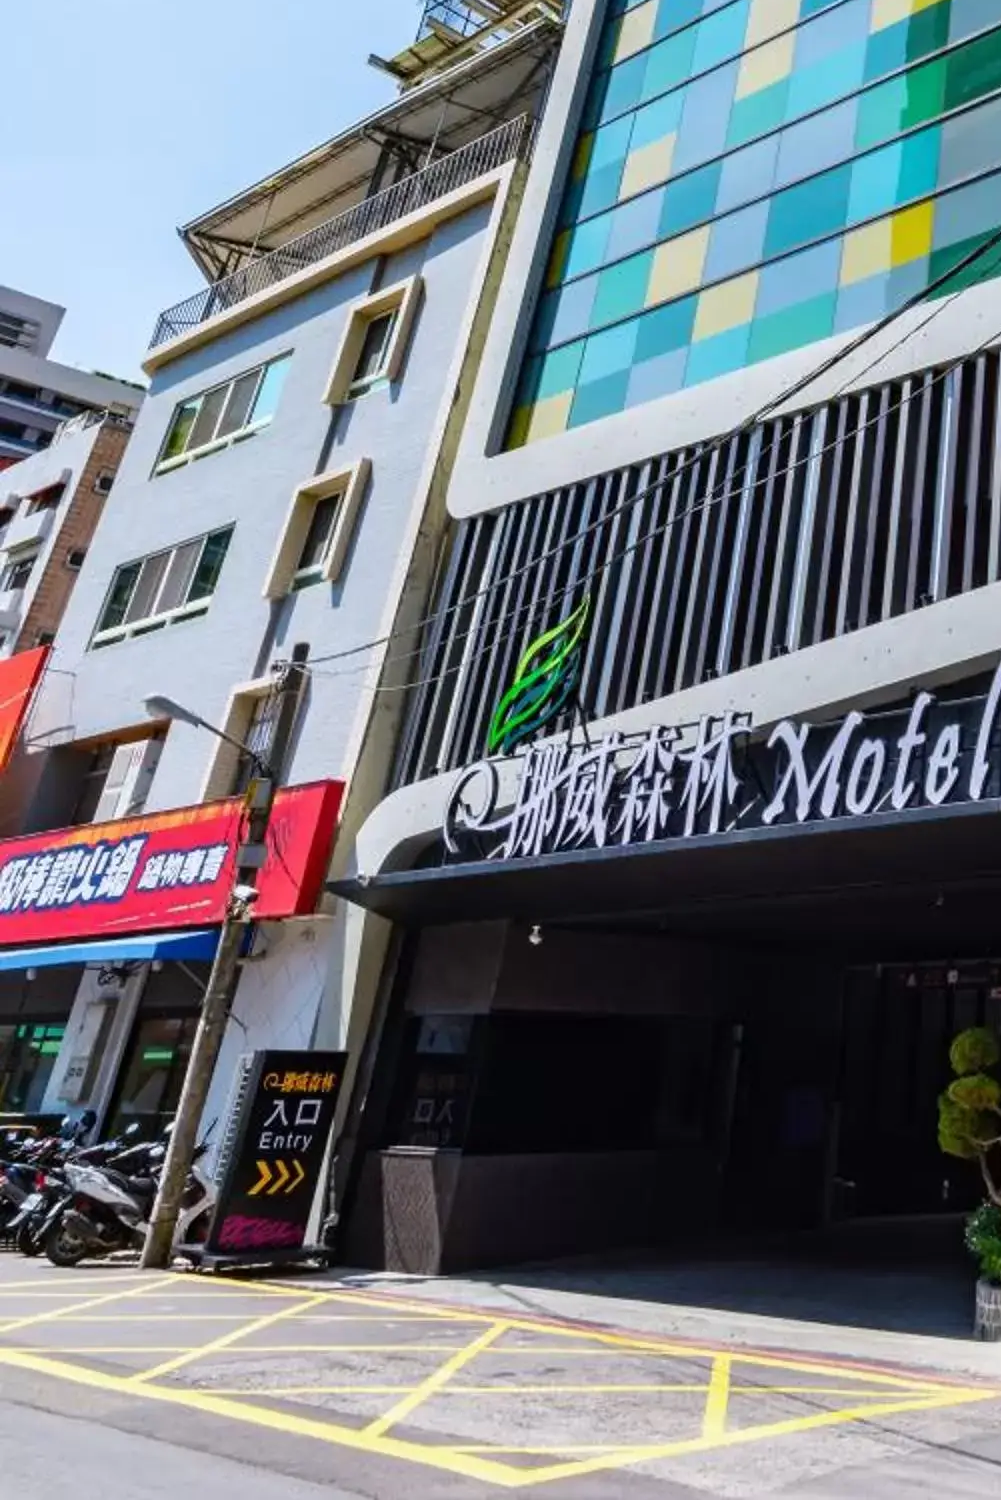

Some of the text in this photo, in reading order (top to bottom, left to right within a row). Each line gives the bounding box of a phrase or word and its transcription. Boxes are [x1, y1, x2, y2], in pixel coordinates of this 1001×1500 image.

[490, 710, 752, 859] 挪威森林
[264, 1099, 322, 1127] 入口
[259, 1131, 313, 1152] Entry
